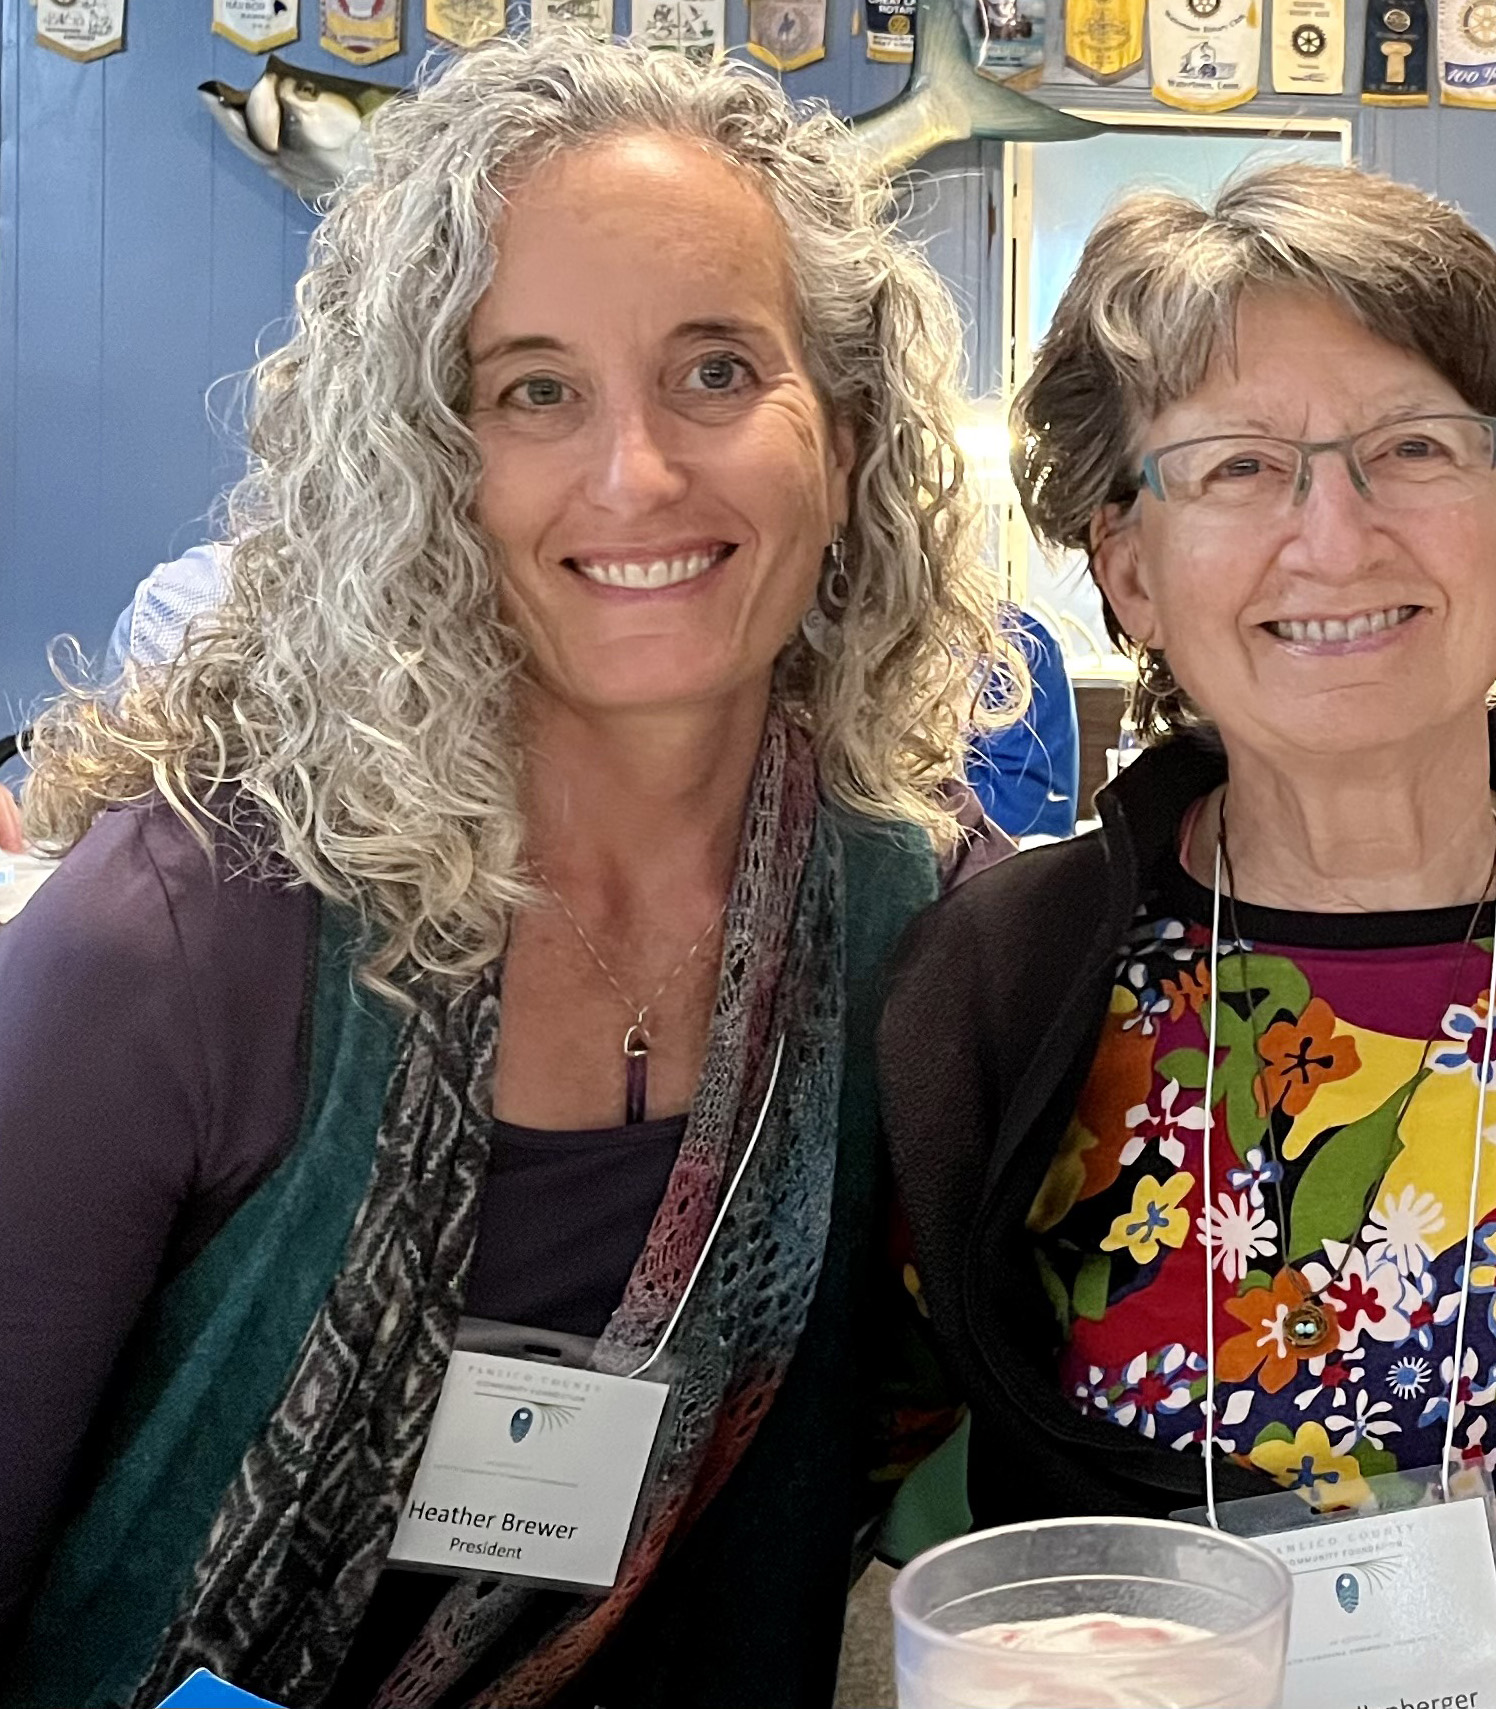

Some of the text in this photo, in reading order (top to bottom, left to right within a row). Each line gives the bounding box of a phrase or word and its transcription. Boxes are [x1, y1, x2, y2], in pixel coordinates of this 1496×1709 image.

[1447, 69, 1479, 83] 100
[408, 1499, 579, 1541] Heather Brewer
[450, 1536, 523, 1560] President
[1276, 1536, 1338, 1555] AMLICO
[1288, 1550, 1339, 1567] OMMUNITY
